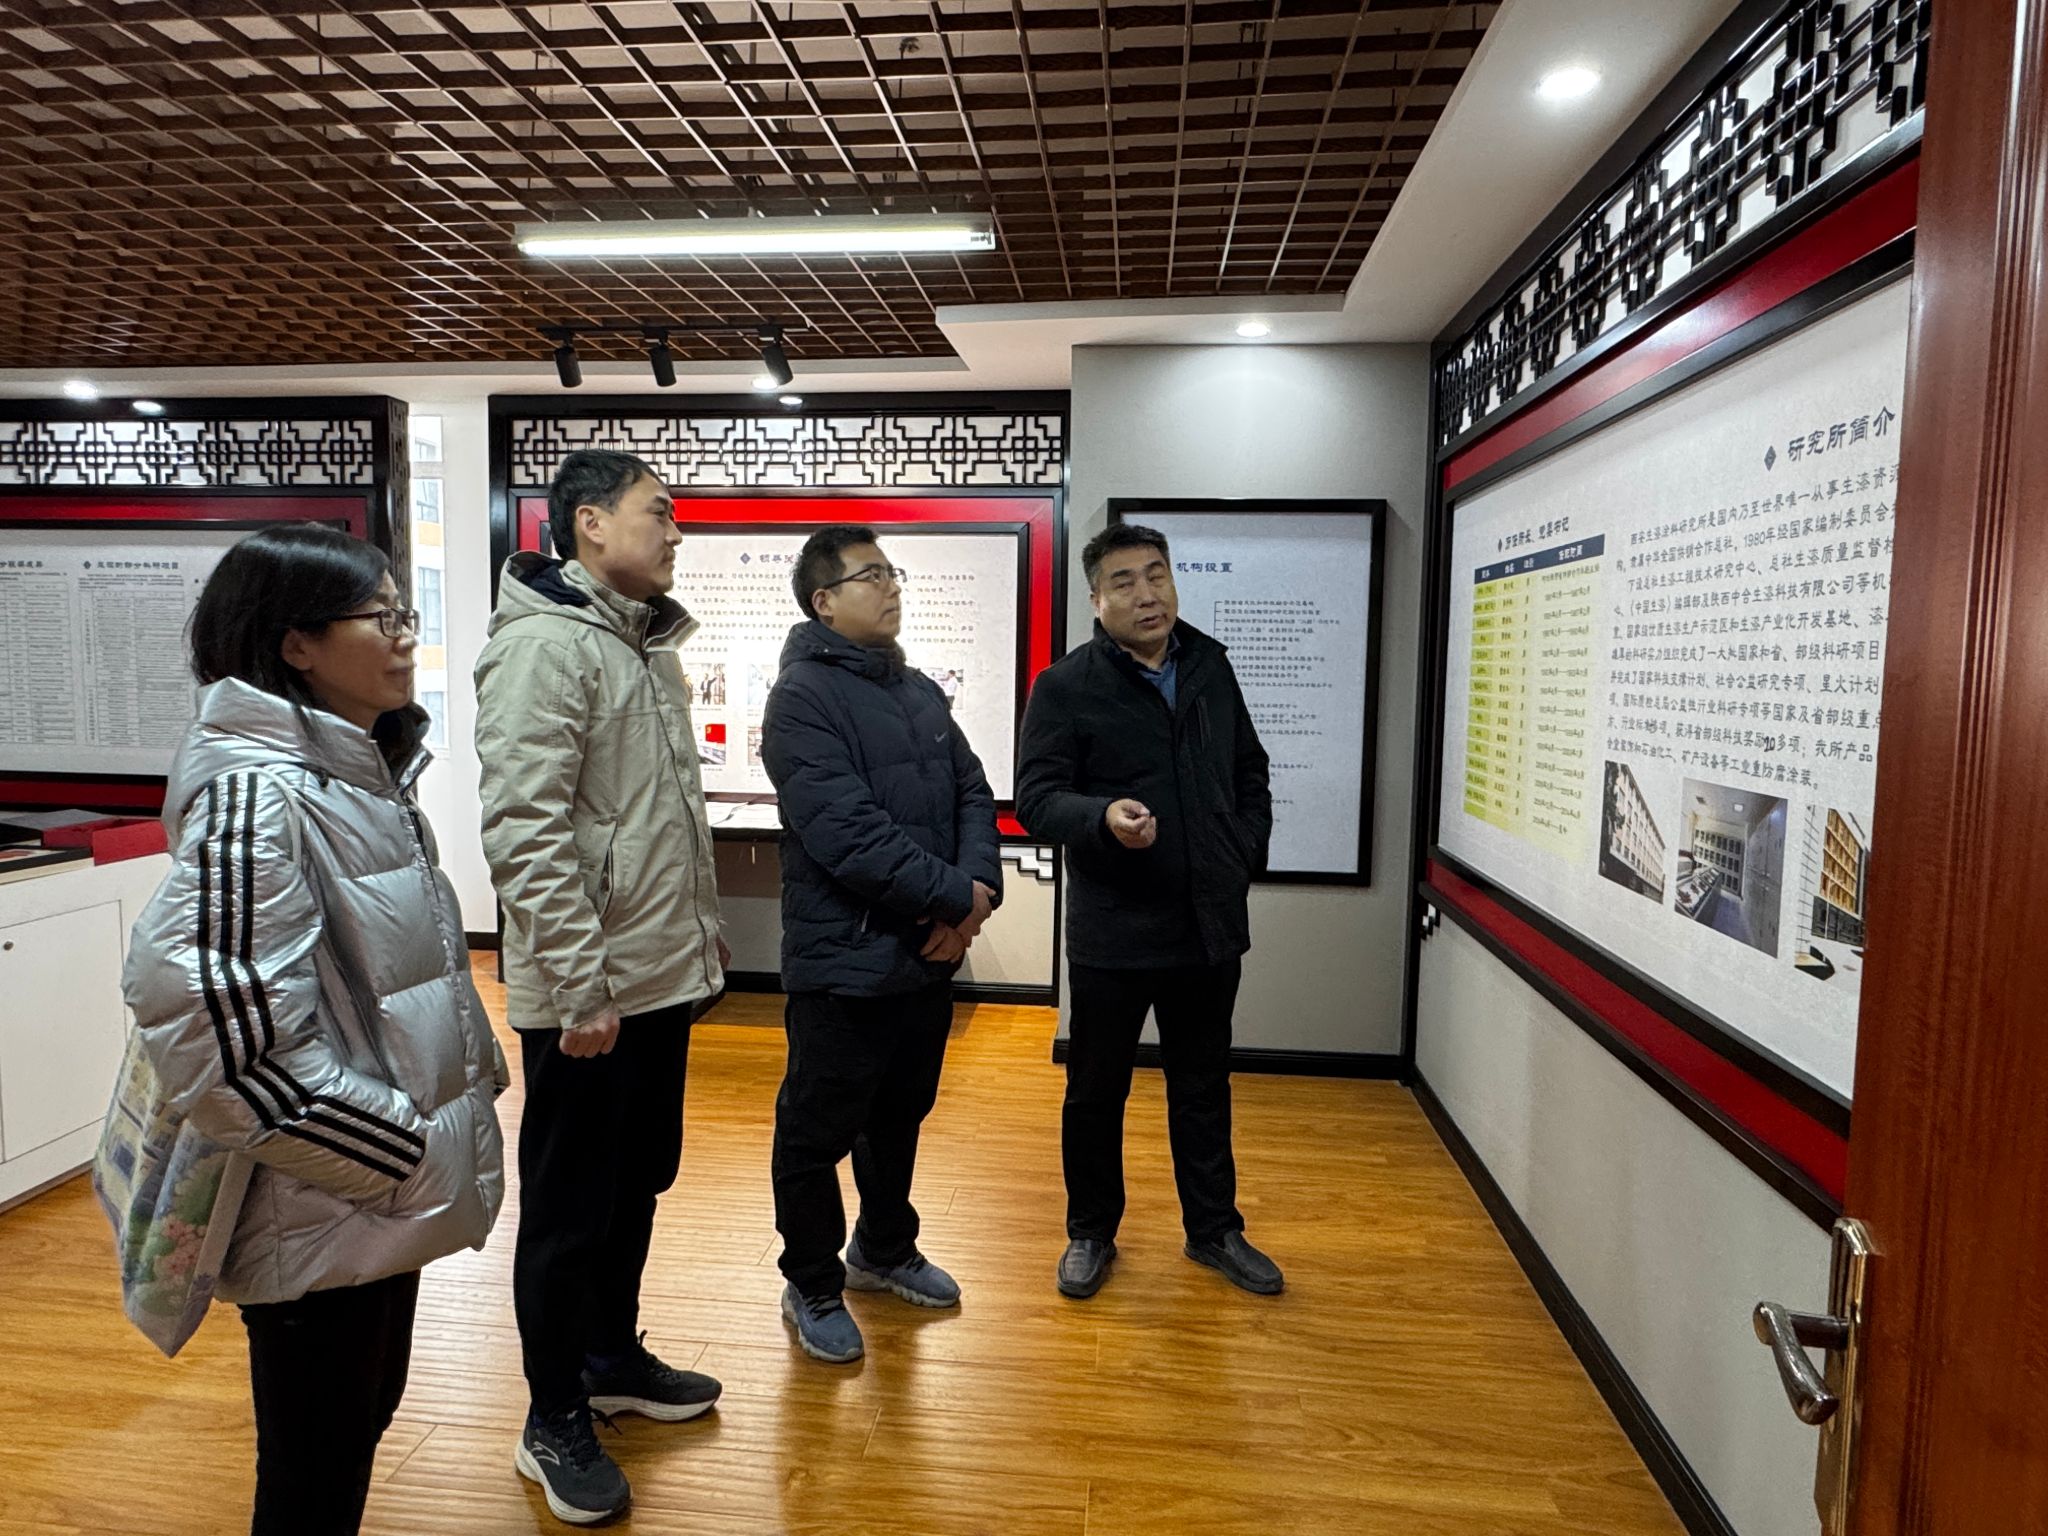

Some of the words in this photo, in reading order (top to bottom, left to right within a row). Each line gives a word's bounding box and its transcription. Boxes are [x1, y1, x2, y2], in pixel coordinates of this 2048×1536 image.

[1787, 406, 1896, 461] 研究所简介
[1176, 562, 1232, 573] 机构设置
